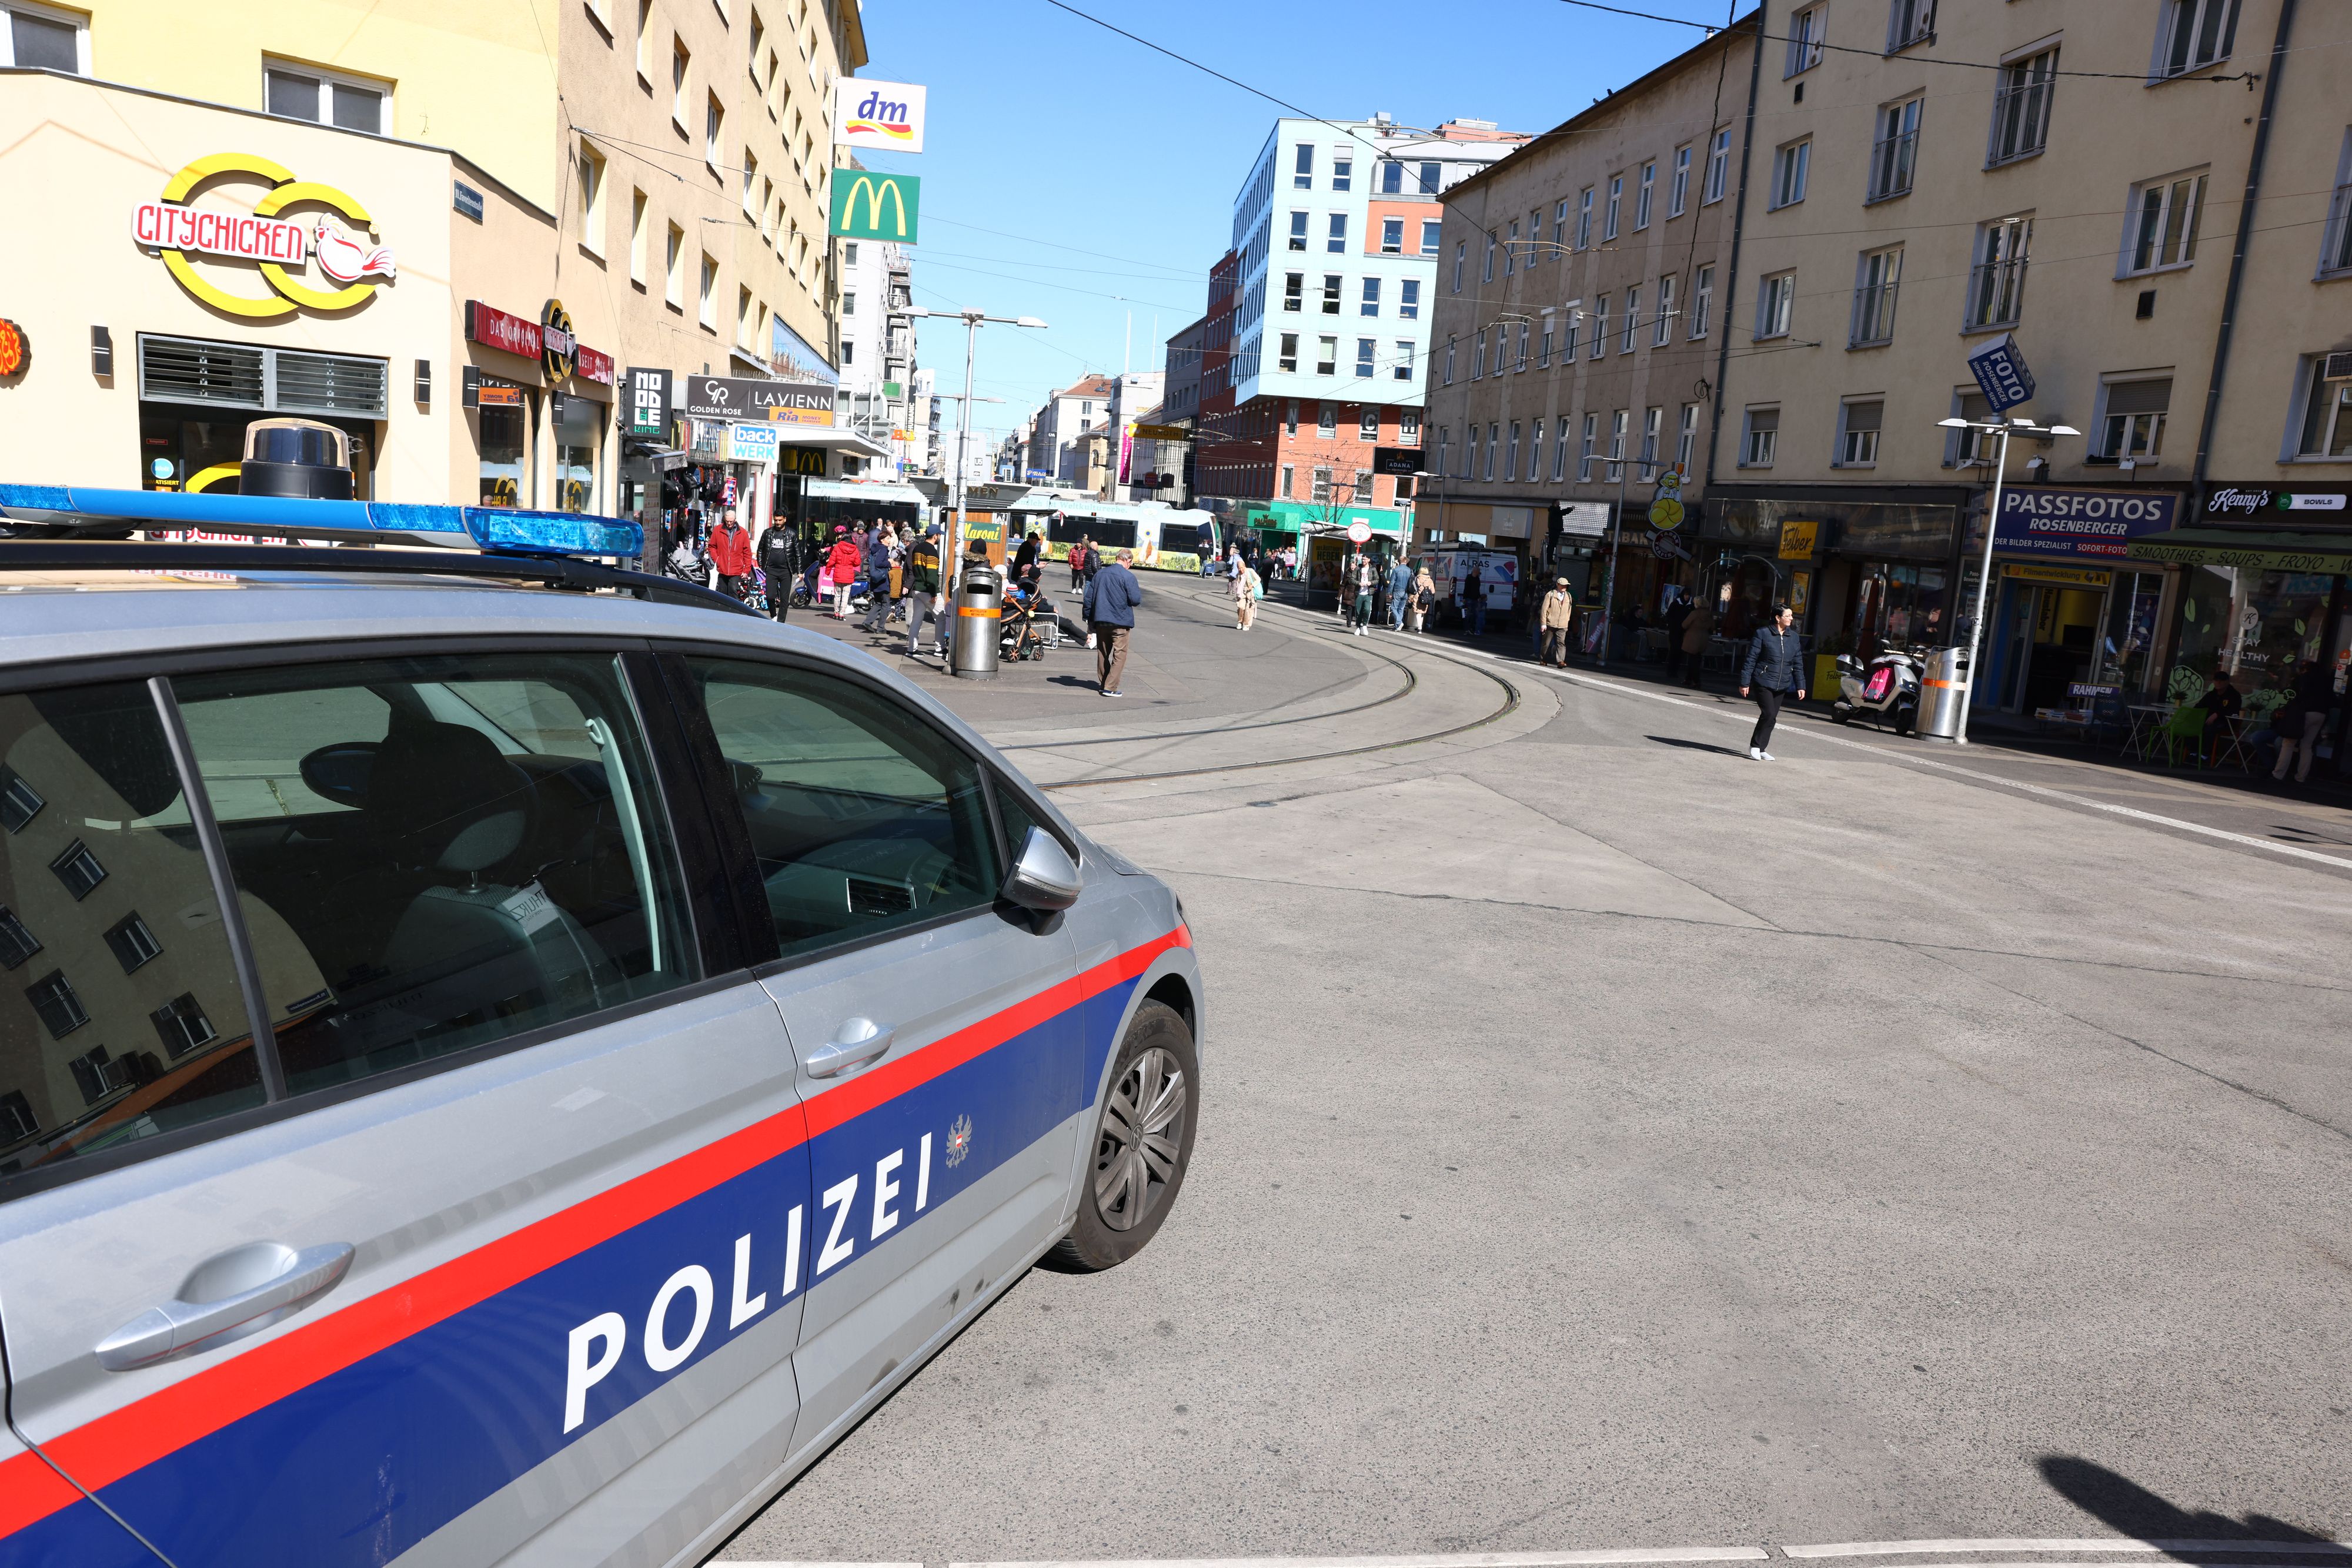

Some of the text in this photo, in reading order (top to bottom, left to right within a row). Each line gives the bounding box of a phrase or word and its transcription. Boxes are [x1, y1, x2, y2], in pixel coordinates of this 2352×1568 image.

[858, 91, 907, 123] dm
[138, 205, 303, 260] CITYCHICKEN
[490, 319, 539, 350] DAS ORIGINAL
[581, 354, 593, 369] SEIT
[1982, 360, 2009, 403] ROSENBERGER
[1990, 350, 2024, 400] FOTO
[1972, 360, 2000, 410] SOFORT-FOTO-SERVICE
[754, 391, 831, 410] LAVIENN
[690, 405, 741, 416] GOLDEN ROSE
[777, 409, 799, 422] Ria
[906, 402, 915, 433] HUMANIC
[634, 426, 660, 434] KING
[736, 427, 774, 444] back
[1142, 427, 1179, 437] NEUROTH
[734, 444, 776, 460] WERK
[1059, 501, 1128, 513] Weltkulturerbe.
[2004, 493, 2162, 520] PASSFOTOS
[2209, 488, 2270, 514] Kenny's
[2029, 518, 2128, 536] ROSENBERGER
[1659, 531, 1679, 544] TABAK
[1783, 527, 1812, 551] Felber
[1994, 538, 2008, 546] DER
[2009, 539, 2032, 547] BILDER
[2034, 540, 2072, 550] SPEZIALIST
[2133, 546, 2205, 561] SMOOTHIES
[2217, 551, 2264, 565] SOUPS
[2277, 556, 2325, 571] FROYO
[2023, 569, 2081, 580] Filmentwicklung
[1589, 621, 1604, 644] Heute
[2232, 636, 2261, 647] STAY
[2217, 648, 2270, 663] HEALTHY
[1826, 670, 1842, 681] Felbe
[563, 1132, 932, 1435] POLIZEI
